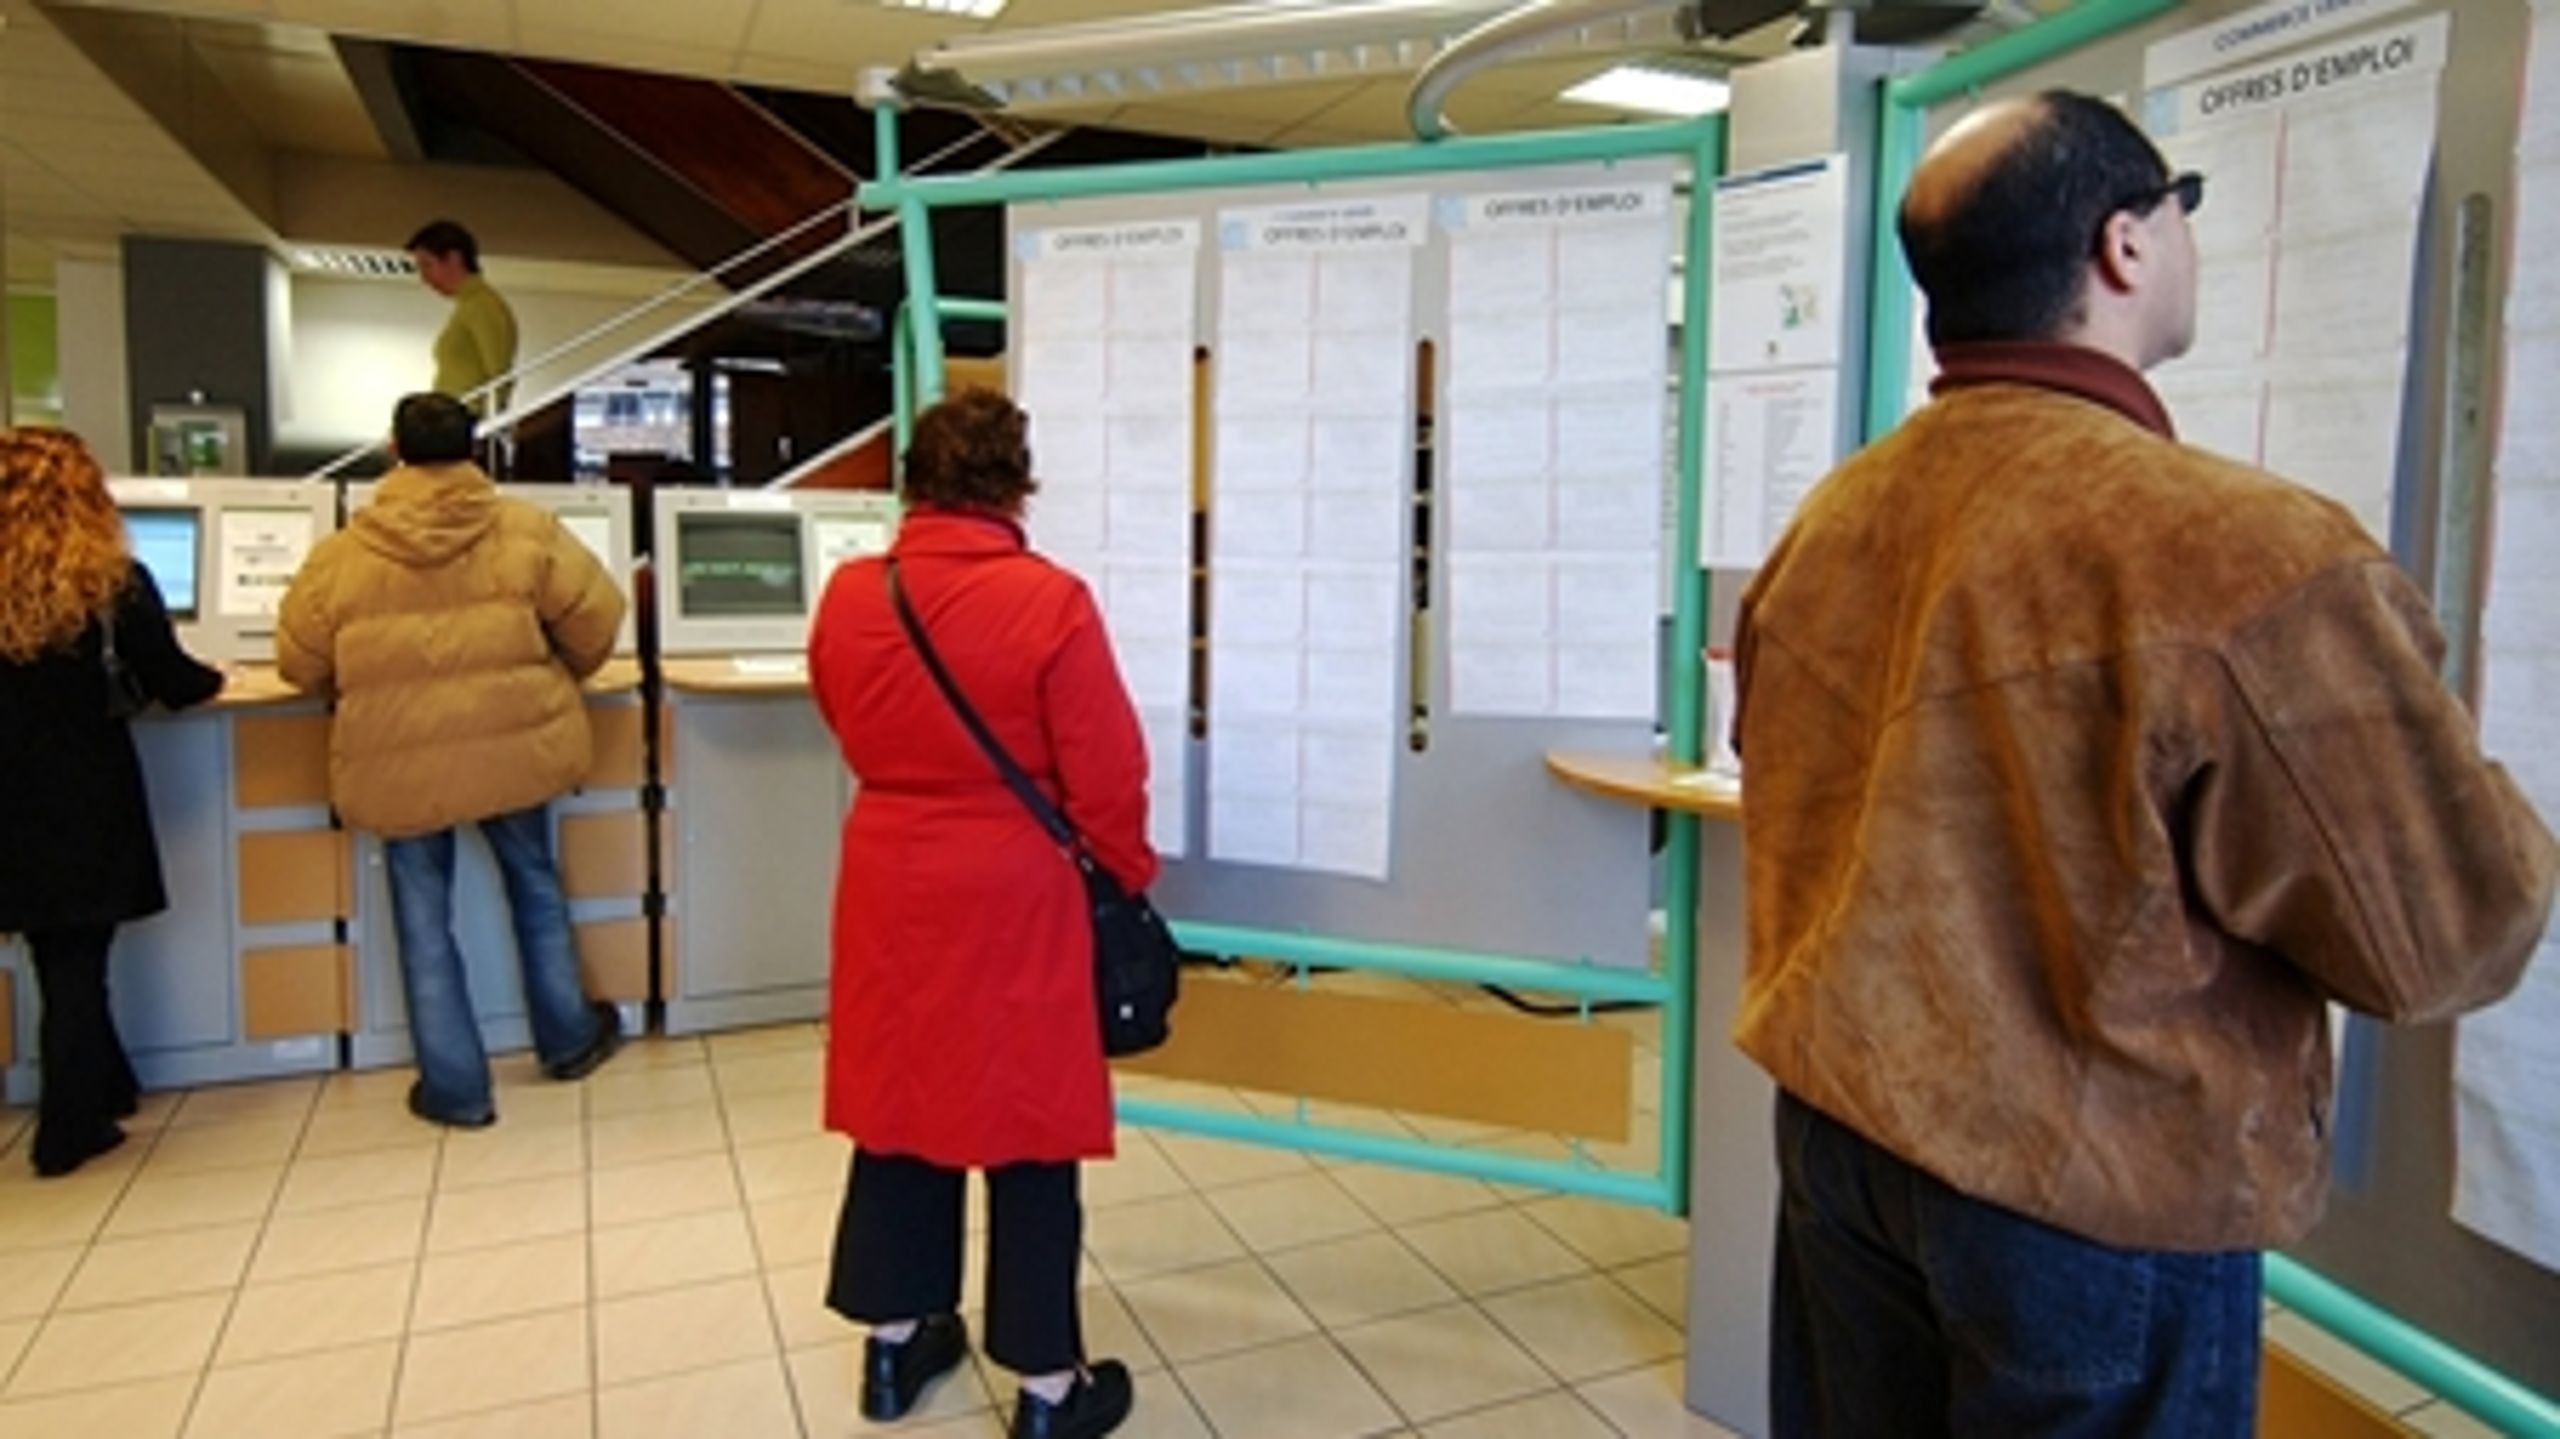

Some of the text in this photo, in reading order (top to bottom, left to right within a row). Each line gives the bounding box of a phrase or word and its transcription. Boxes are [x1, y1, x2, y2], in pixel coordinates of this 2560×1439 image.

[2200, 34, 2416, 115] OFFRES D'EMPLOI
[1484, 192, 1642, 220] OFFRES D'EMPLOI
[1053, 231, 1111, 252] OFFRES
[1263, 223, 1326, 245] OFFRES
